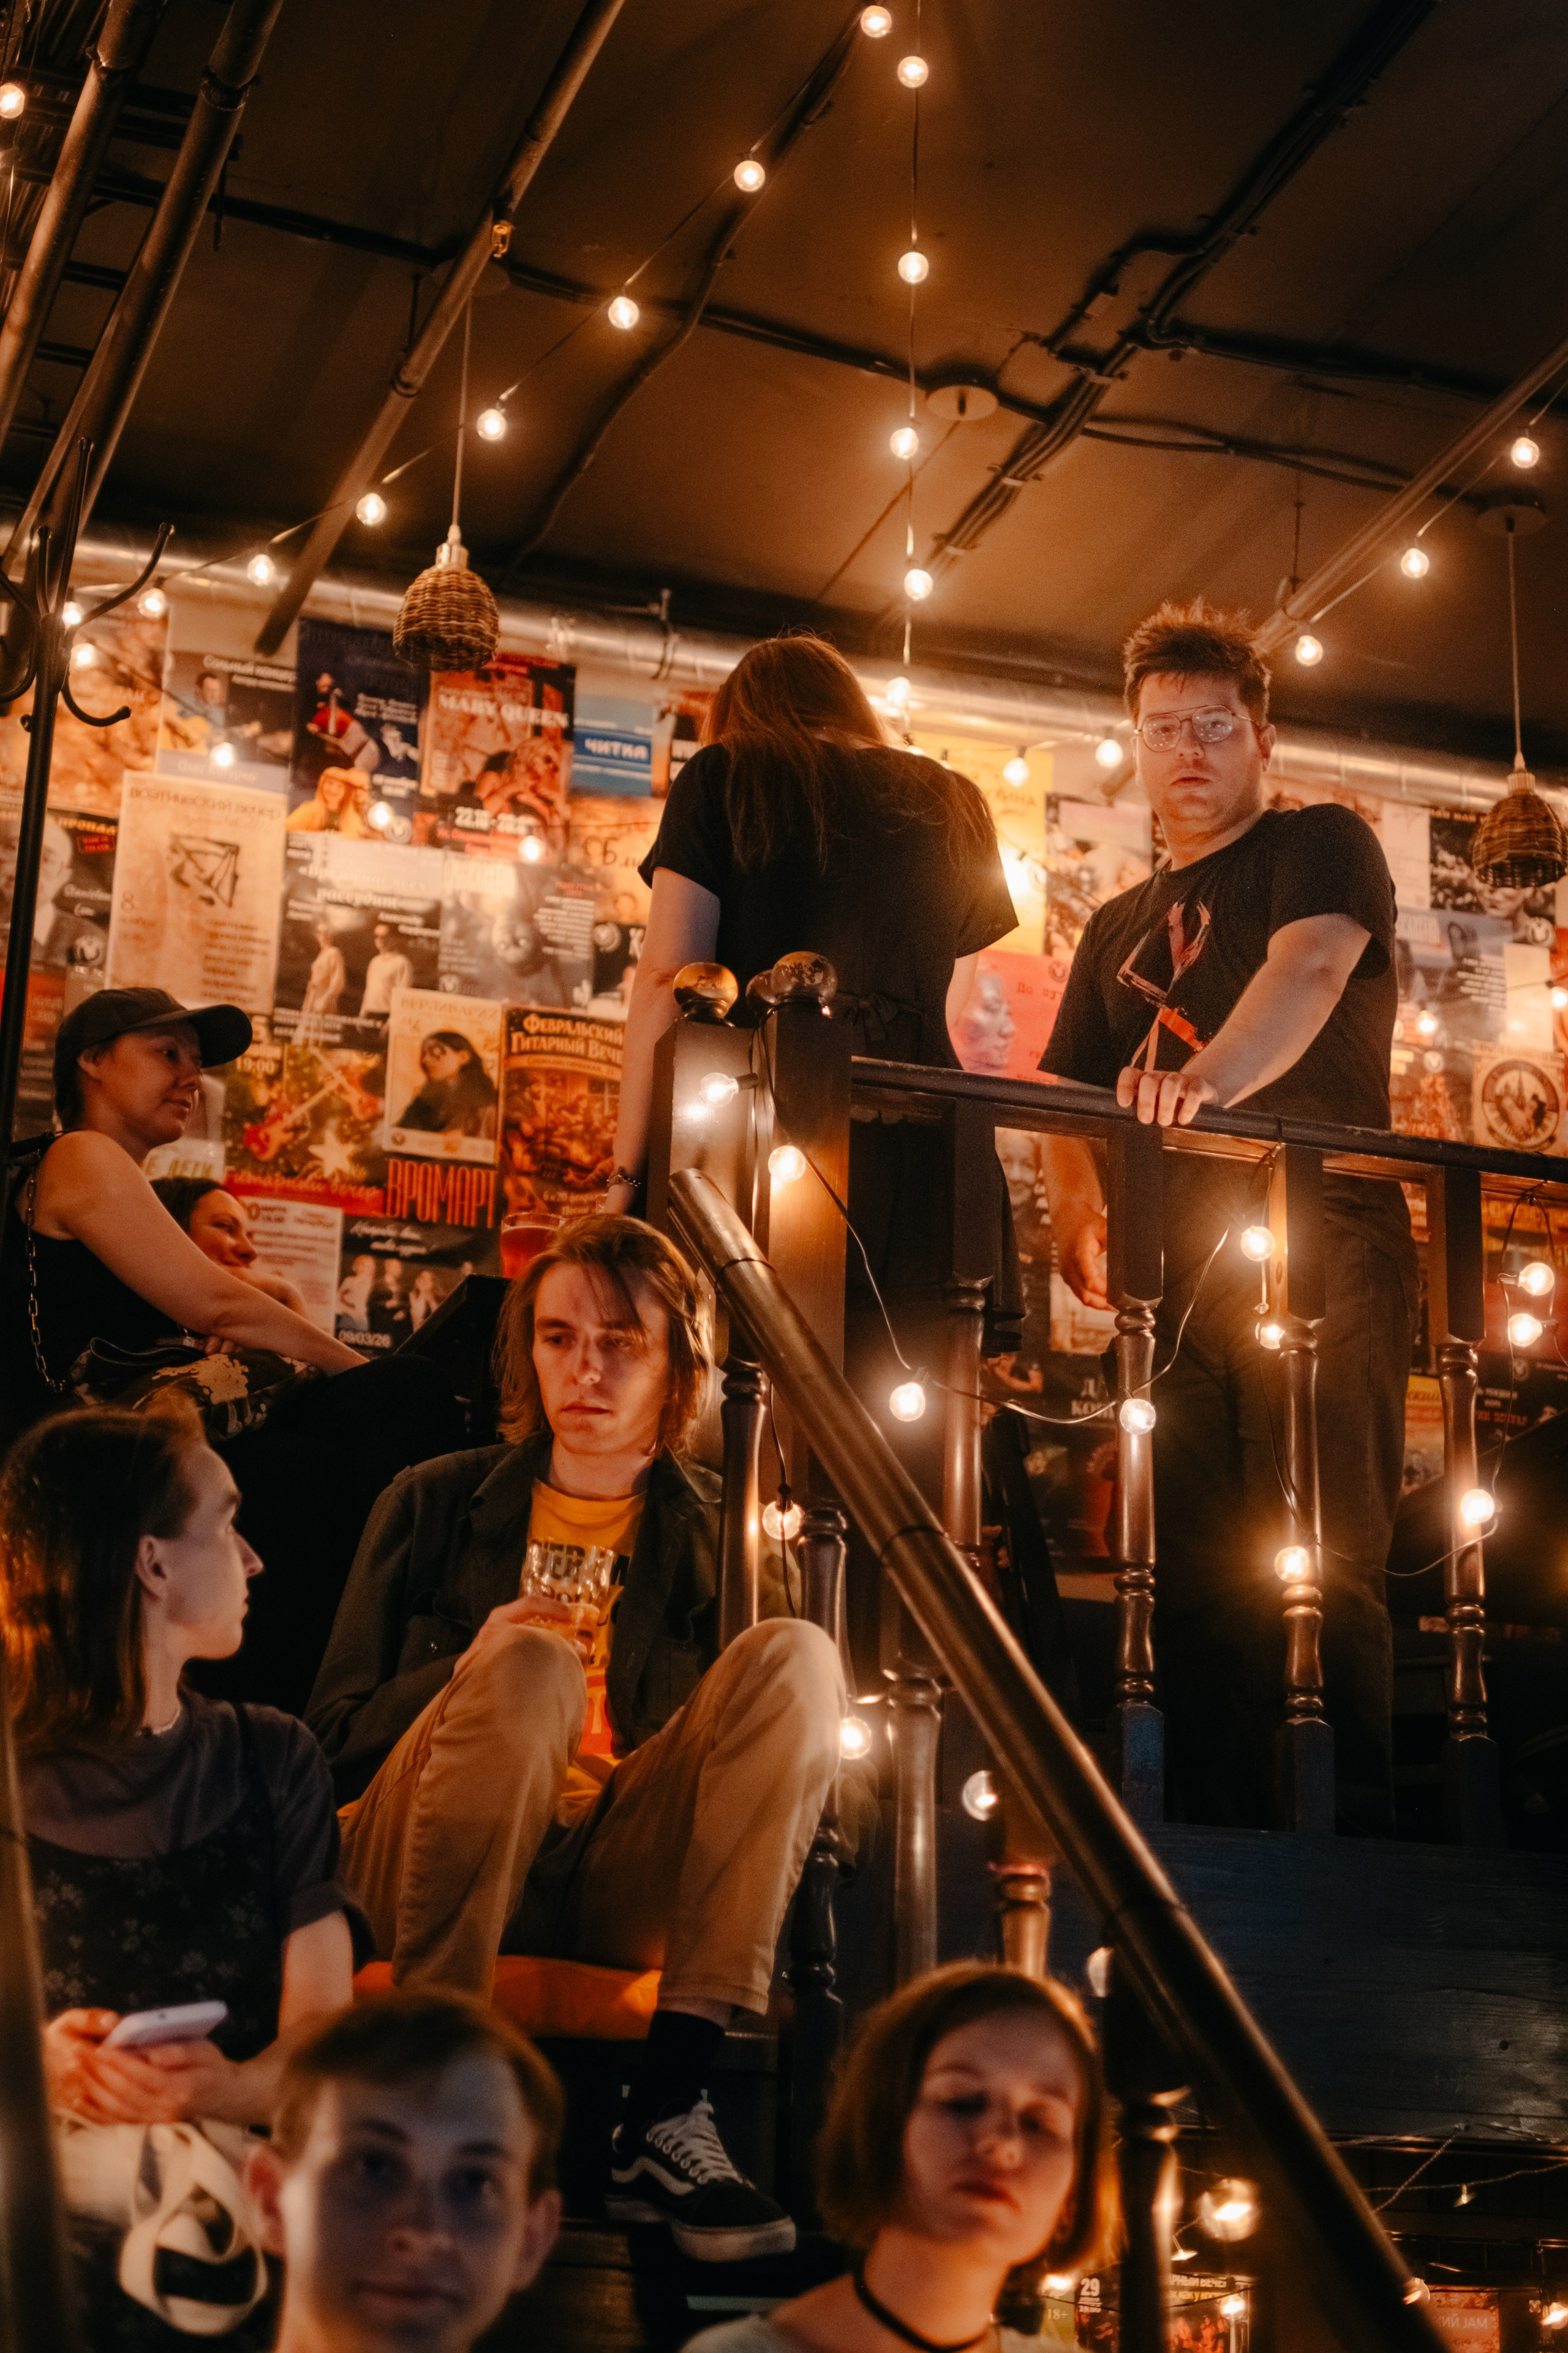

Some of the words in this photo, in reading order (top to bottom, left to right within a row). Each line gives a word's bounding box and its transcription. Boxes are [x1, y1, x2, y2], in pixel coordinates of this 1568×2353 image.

[439, 693, 496, 716] MARY
[500, 703, 569, 729] QUEEN
[585, 738, 649, 760] ЧИТКА
[522, 1013, 623, 1046] ФЕВРАЛЬСКИЙ
[510, 1031, 586, 1058] ГИТАРНЫЙ
[589, 1038, 623, 1065] ВЕЧЕ
[1080, 2277, 1100, 2297] 29
[1047, 2308, 1069, 2321] 18+
[1463, 2316, 1488, 2329] JAM
